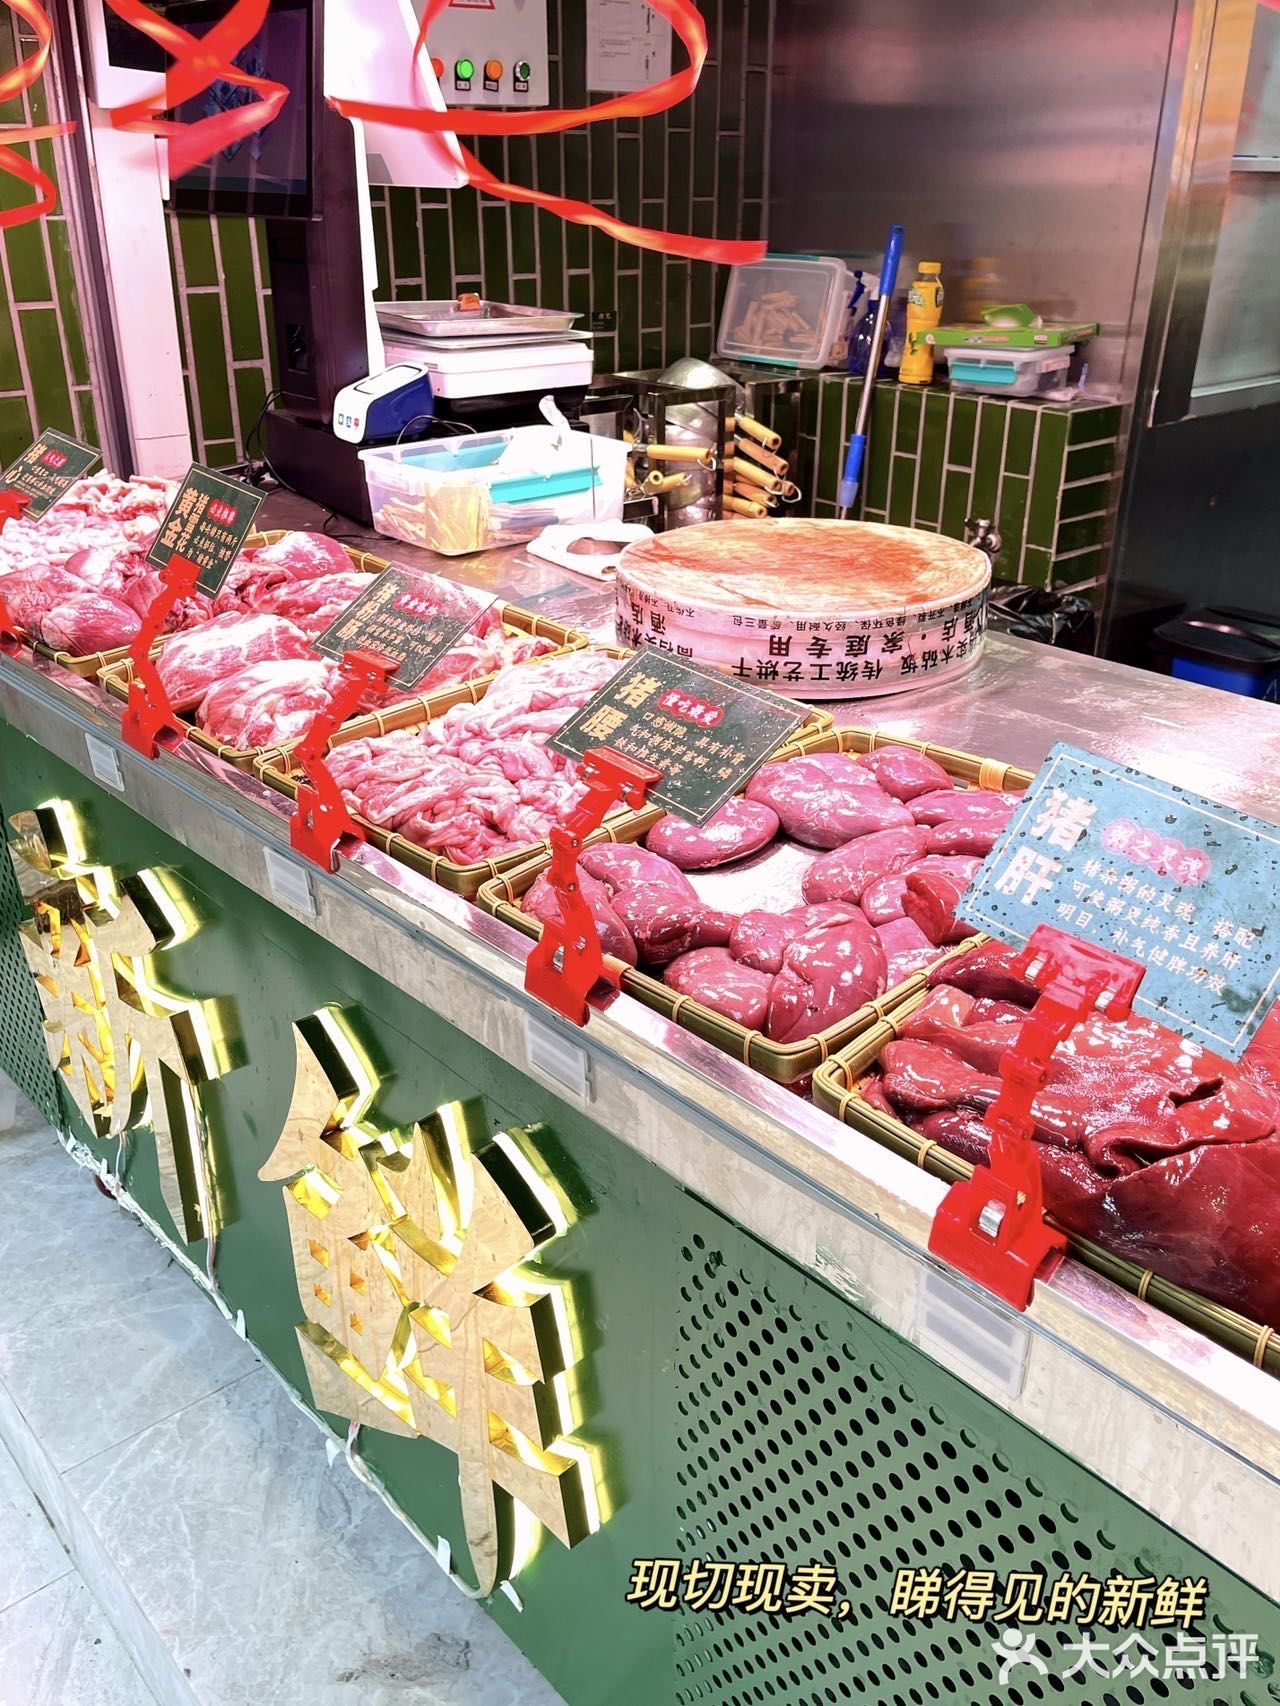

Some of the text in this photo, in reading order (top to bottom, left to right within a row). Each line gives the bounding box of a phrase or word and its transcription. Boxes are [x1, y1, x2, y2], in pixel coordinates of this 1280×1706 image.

[160, 487, 199, 549] 黄金
[730, 656, 883, 684] 传统工艺烘干
[579, 671, 662, 742] 猪腰
[993, 788, 1098, 906] 猪肝
[1106, 824, 1205, 886] 粥之灵魂
[7, 800, 608, 1598] 新鲜
